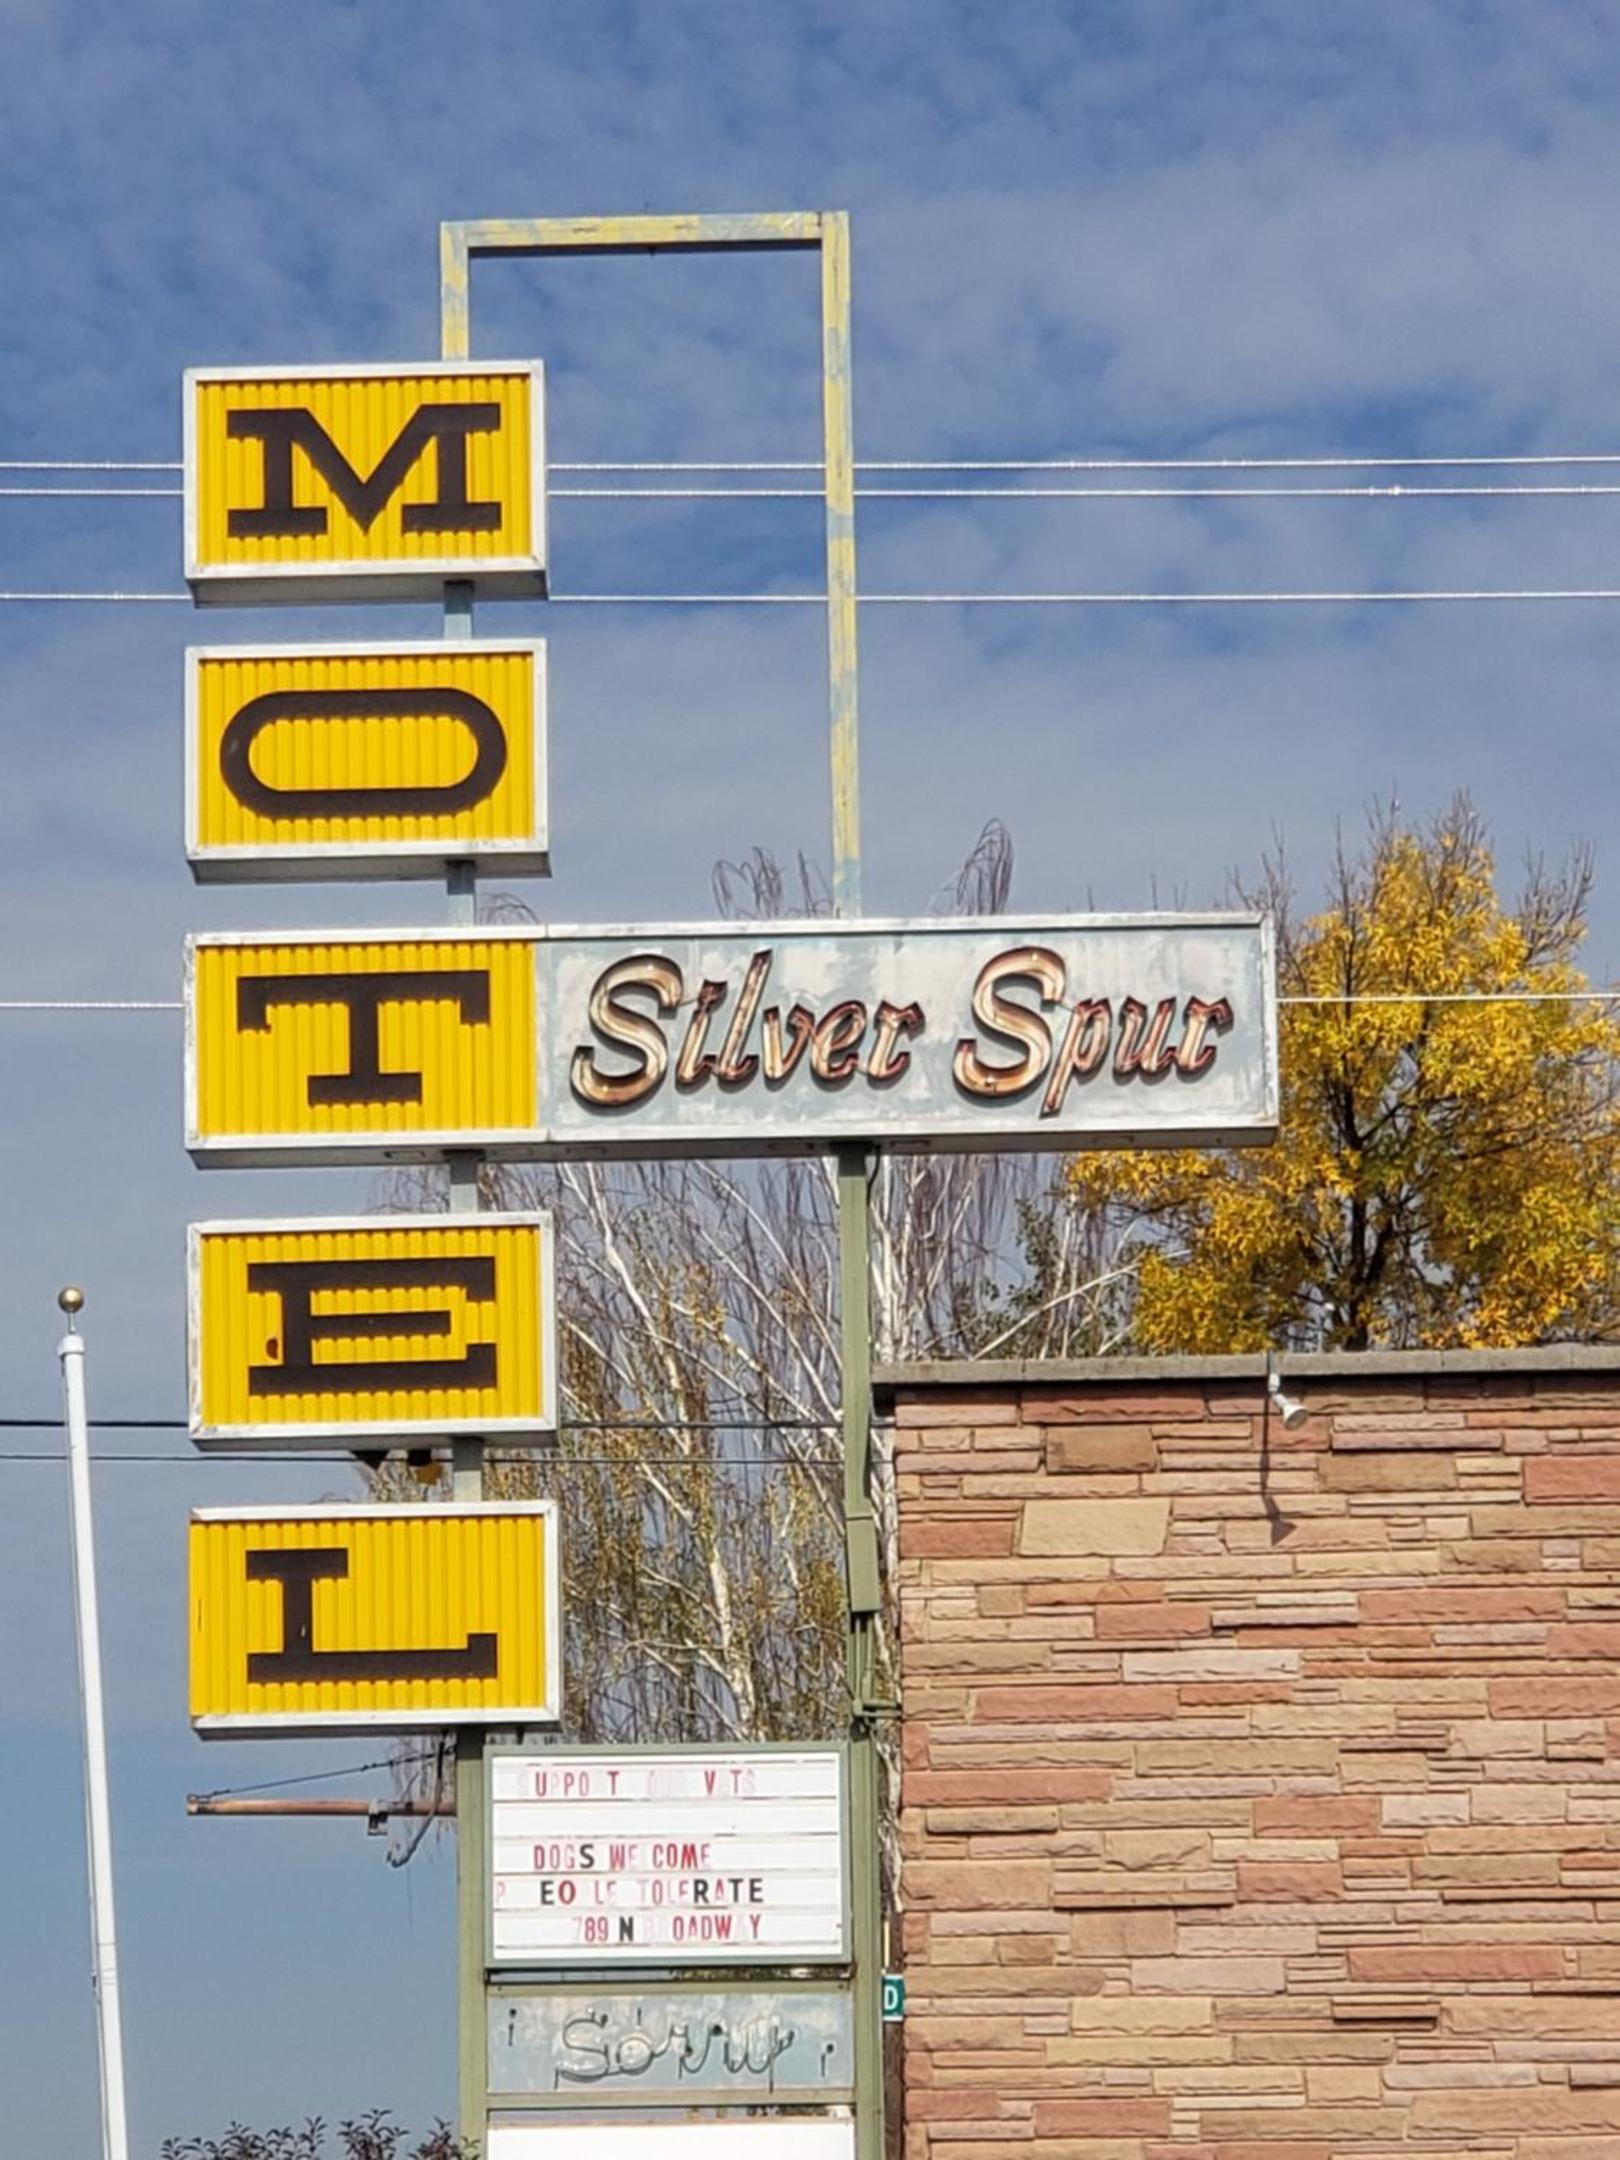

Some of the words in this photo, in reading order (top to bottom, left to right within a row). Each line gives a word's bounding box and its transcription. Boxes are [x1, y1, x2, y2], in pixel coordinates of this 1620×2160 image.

[220, 402, 507, 1684] MOTEL
[570, 949, 924, 1107] Silver
[952, 945, 1234, 1119] Spur
[533, 1842, 596, 1870] DOGS
[609, 1841, 712, 1870] WECOME
[618, 1915, 635, 1942] N
